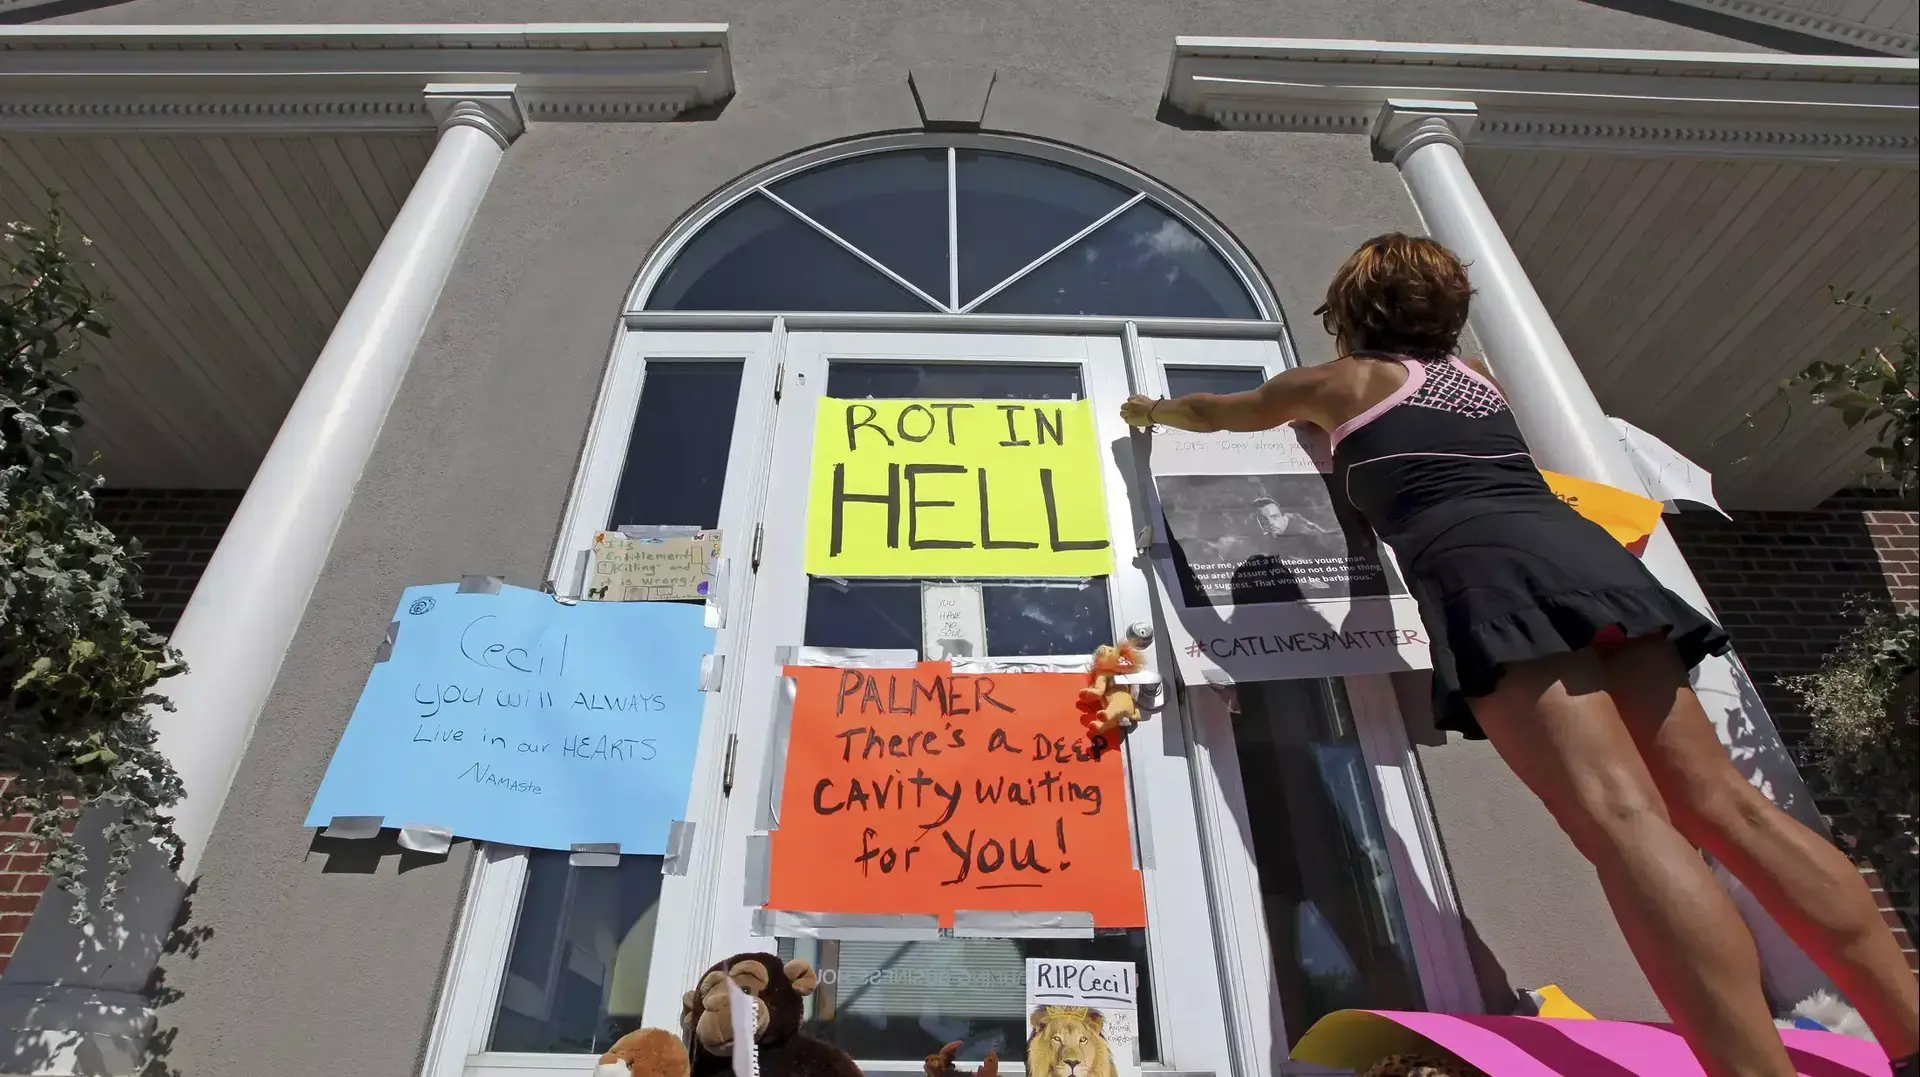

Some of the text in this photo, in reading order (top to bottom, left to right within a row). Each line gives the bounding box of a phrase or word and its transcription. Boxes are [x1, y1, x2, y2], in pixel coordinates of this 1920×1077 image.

[846, 403, 1064, 451] ROT IN
[829, 462, 1111, 557] HELL
[670, 563, 691, 571] and
[1192, 573, 1209, 581] you
[1237, 570, 1267, 578] assure
[1269, 568, 1286, 576] you
[1237, 559, 1261, 567] what
[1271, 556, 1313, 566] righteous
[1195, 584, 1212, 592] you
[1255, 579, 1276, 587] That
[1278, 576, 1307, 585] would
[460, 615, 569, 676] Cecil
[1185, 629, 1427, 659] #CATLIVESMATTER
[496, 690, 553, 709] will
[571, 691, 666, 712] ALWAYS
[835, 669, 1016, 717] PALMER
[413, 724, 657, 761] Live in our HEARTS
[836, 721, 1109, 763] There's a DEEP
[855, 827, 920, 877] for
[1079, 965, 1129, 994] Cecil
